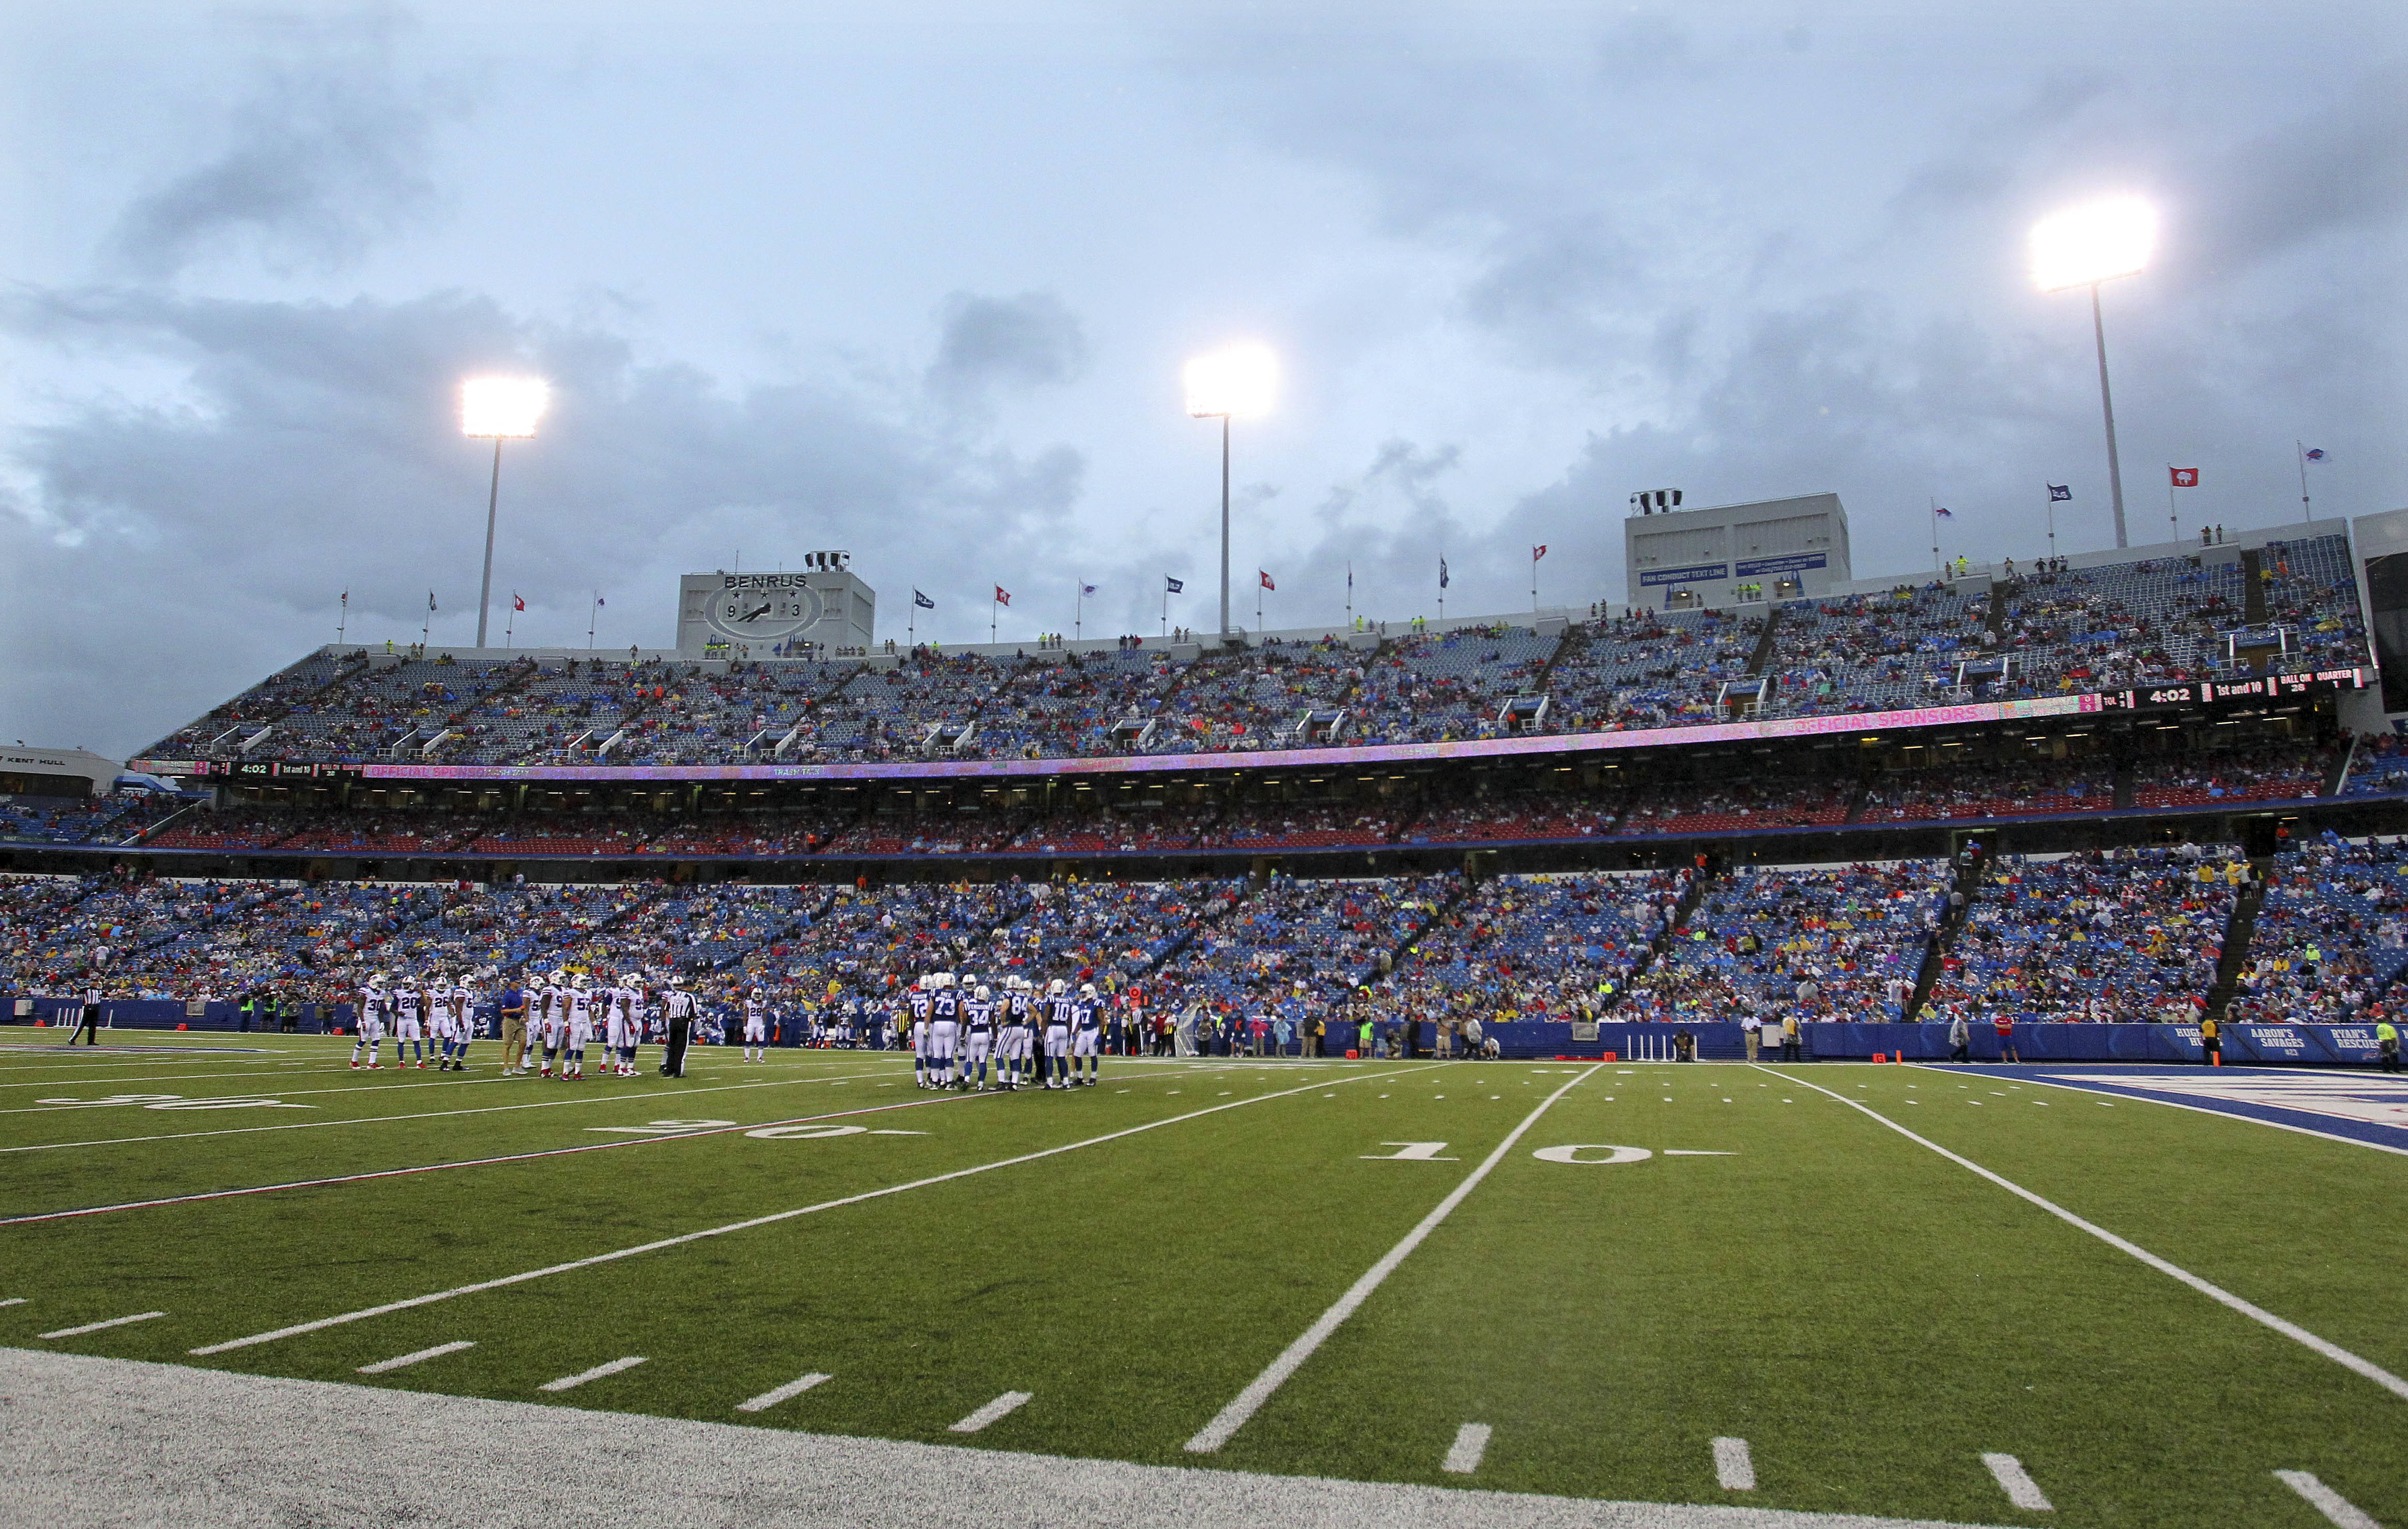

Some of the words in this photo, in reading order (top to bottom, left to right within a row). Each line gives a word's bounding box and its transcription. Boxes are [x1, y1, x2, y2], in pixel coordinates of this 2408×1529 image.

[1658, 572, 1690, 581] CONDUCT
[1692, 570, 1708, 578] TEXT
[1709, 568, 1726, 576] LINE
[725, 575, 806, 588] BENRUS
[728, 606, 735, 617] 9
[792, 604, 800, 616] 3
[2280, 674, 2299, 684] BALL
[2299, 673, 2313, 682] ON
[2317, 670, 2353, 681] QUARTER
[2216, 684, 2230, 696] 1st
[2231, 682, 2250, 695] and
[2251, 681, 2263, 693] 10
[2150, 689, 2191, 703] 4:02
[1795, 718, 1872, 733] OFFICIAL
[1878, 707, 1979, 726] SPONSORS
[241, 764, 266, 773] 4:02
[402, 997, 418, 1008] 20
[911, 999, 929, 1018] 72
[935, 997, 955, 1016] 73
[1011, 997, 1028, 1015] 84
[750, 1008, 762, 1016] 28
[968, 1010, 989, 1026] 34
[1052, 1003, 1070, 1021] 10
[1081, 1010, 1091, 1024] 17
[2250, 1028, 2295, 1038] AARON'S
[2330, 1029, 2369, 1038] RYAN'S
[2260, 1038, 2306, 1048] SAVAGES
[2336, 1039, 2382, 1049] RESCUES
[1358, 1142, 1652, 1164] 10
